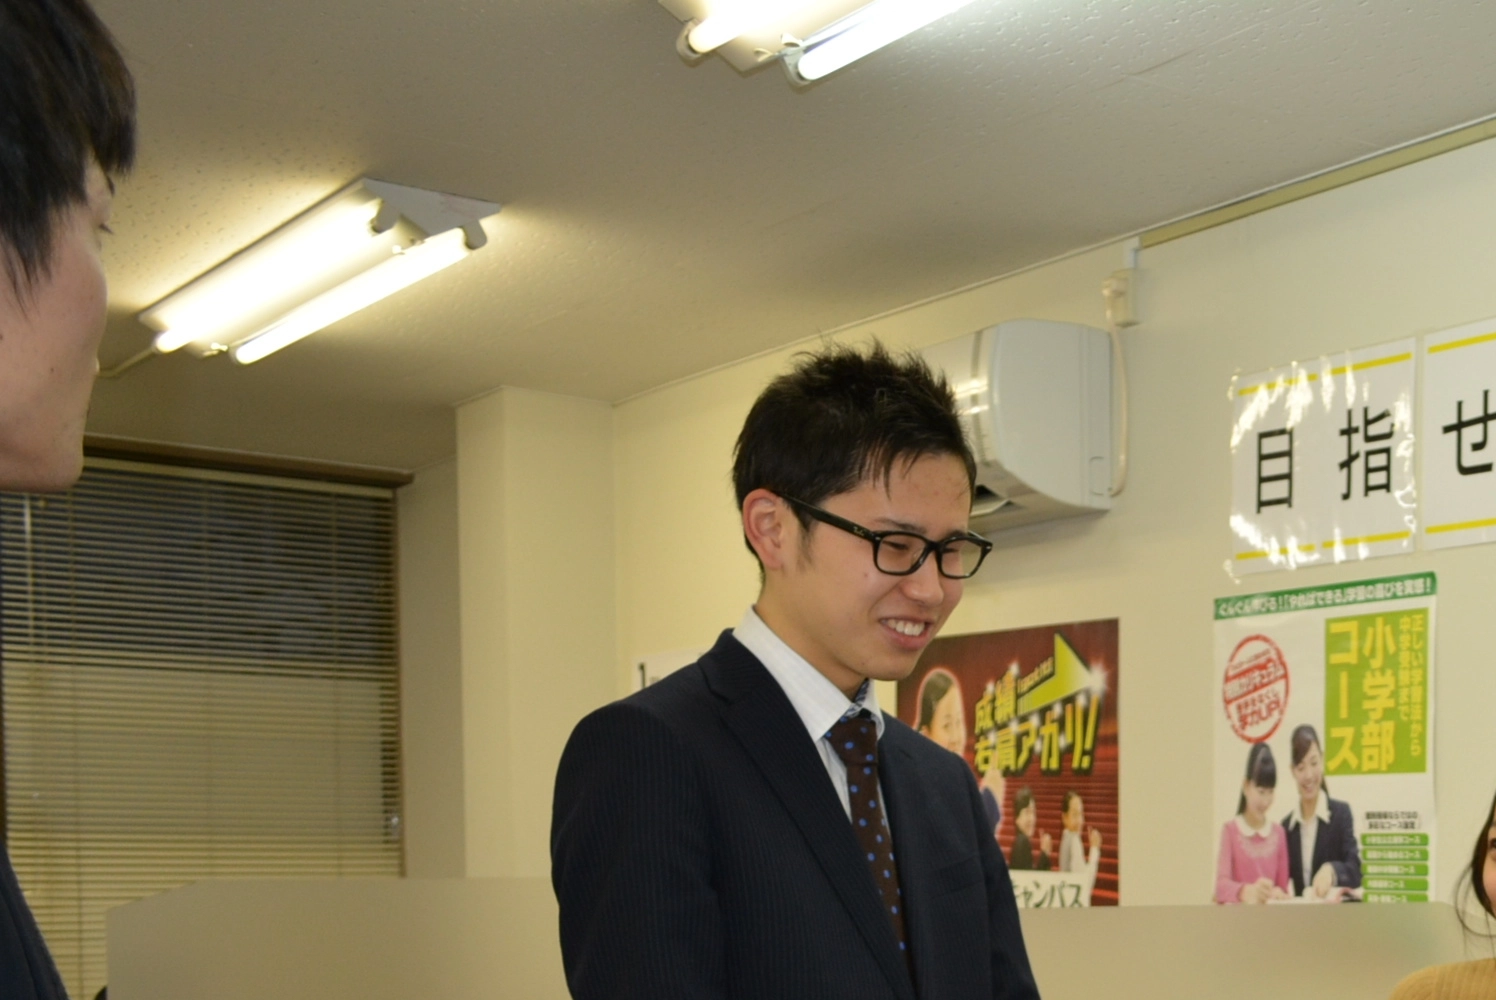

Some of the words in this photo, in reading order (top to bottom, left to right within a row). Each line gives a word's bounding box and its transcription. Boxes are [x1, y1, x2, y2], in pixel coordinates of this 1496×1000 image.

[1327, 619, 1359, 772] コース
[1361, 616, 1398, 772] 小学部
[1014, 879, 1084, 908] ャンパス
